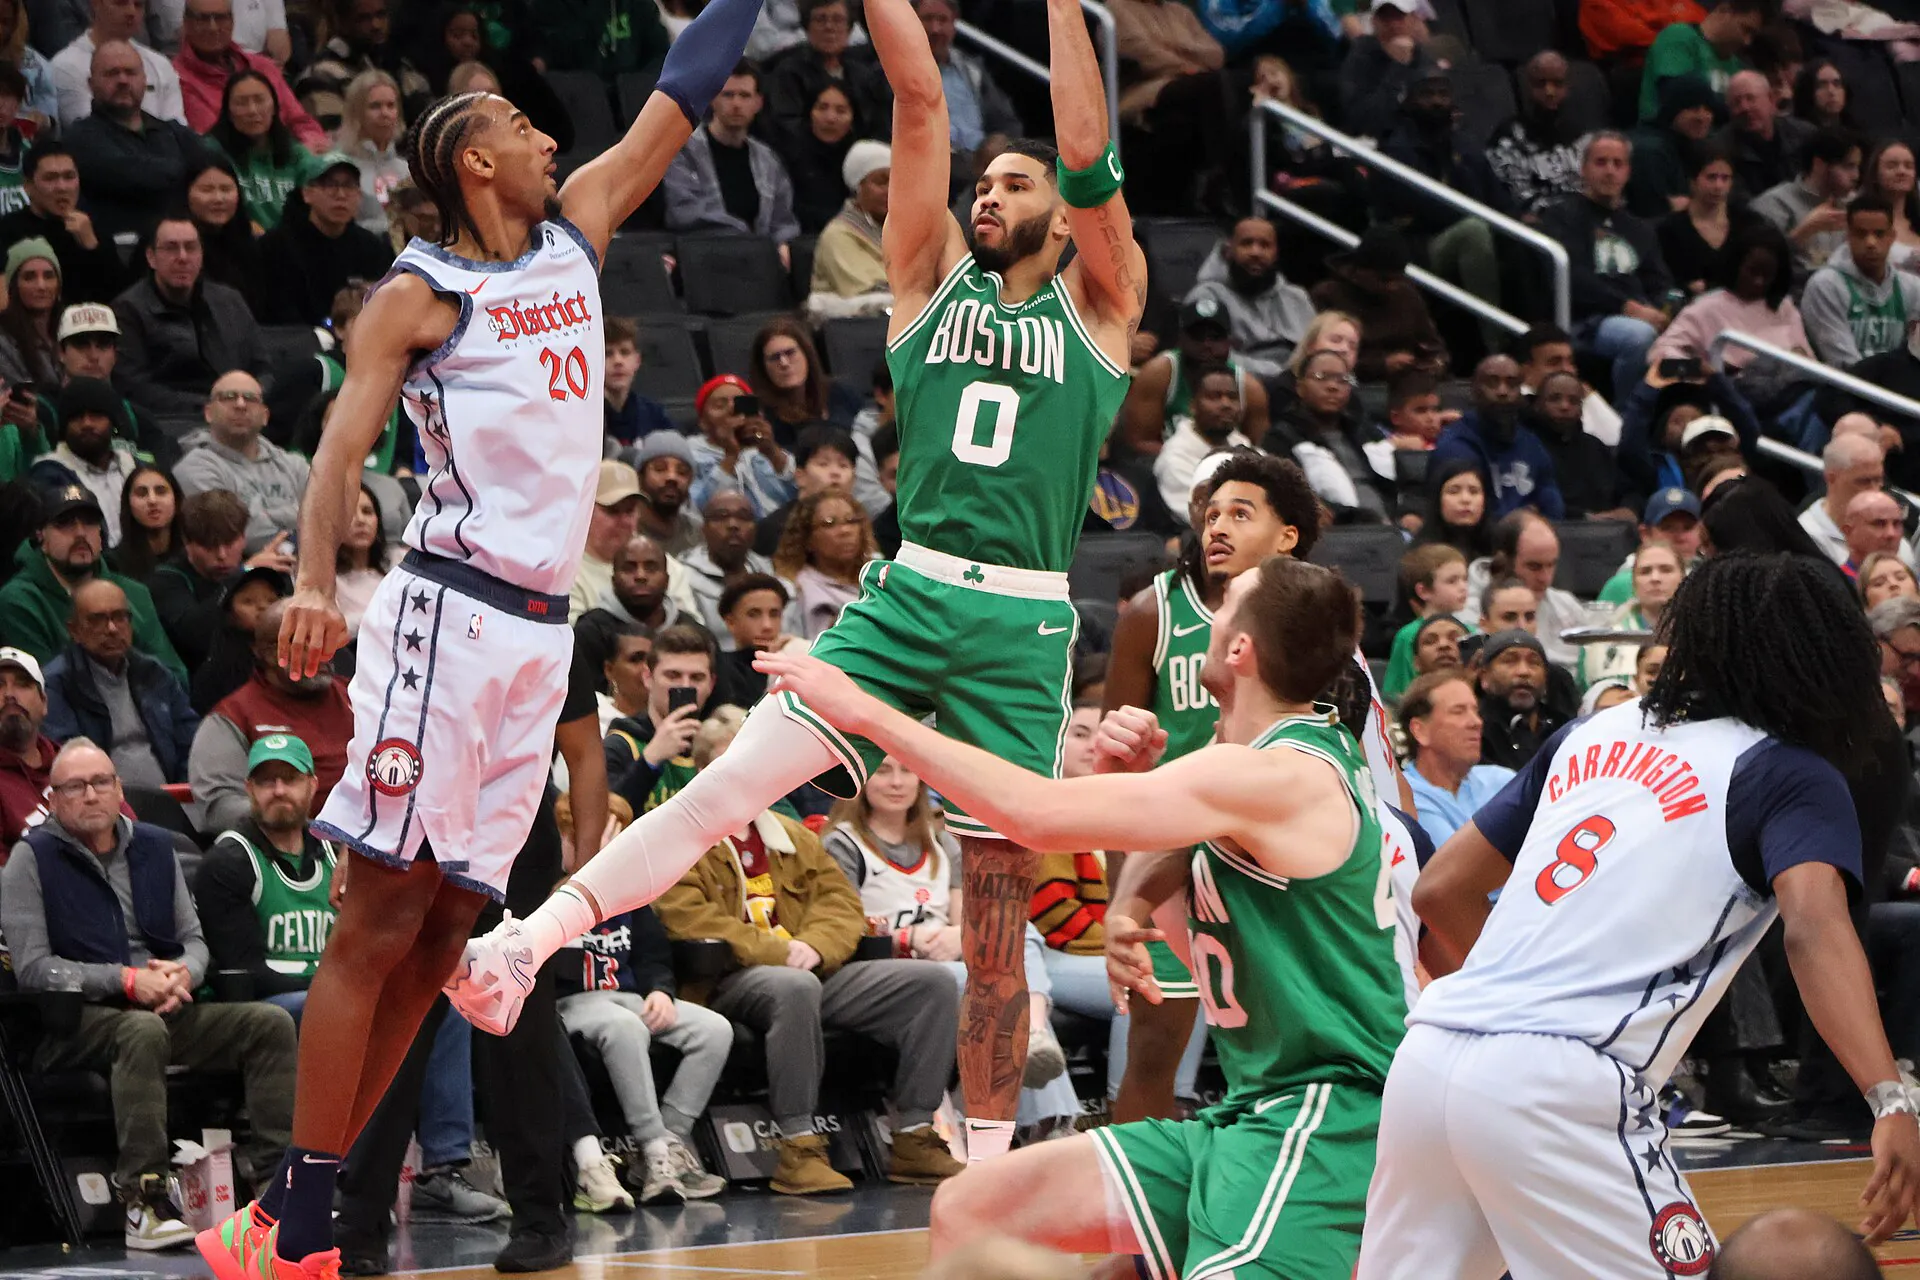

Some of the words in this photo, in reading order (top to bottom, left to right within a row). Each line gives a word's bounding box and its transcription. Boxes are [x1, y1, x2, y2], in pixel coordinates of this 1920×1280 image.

[0, 184, 31, 216] OST
[484, 290, 592, 343] District
[1018, 291, 1056, 314] Amica
[925, 299, 1065, 385] BOSTON
[539, 346, 591, 402] 20
[951, 380, 1021, 468] 0
[1168, 652, 1220, 712] BO
[1548, 741, 1709, 823] CARRINGTON
[1534, 814, 1617, 907] 8
[267, 909, 337, 953] CELTIC
[753, 1115, 842, 1139] CARS
